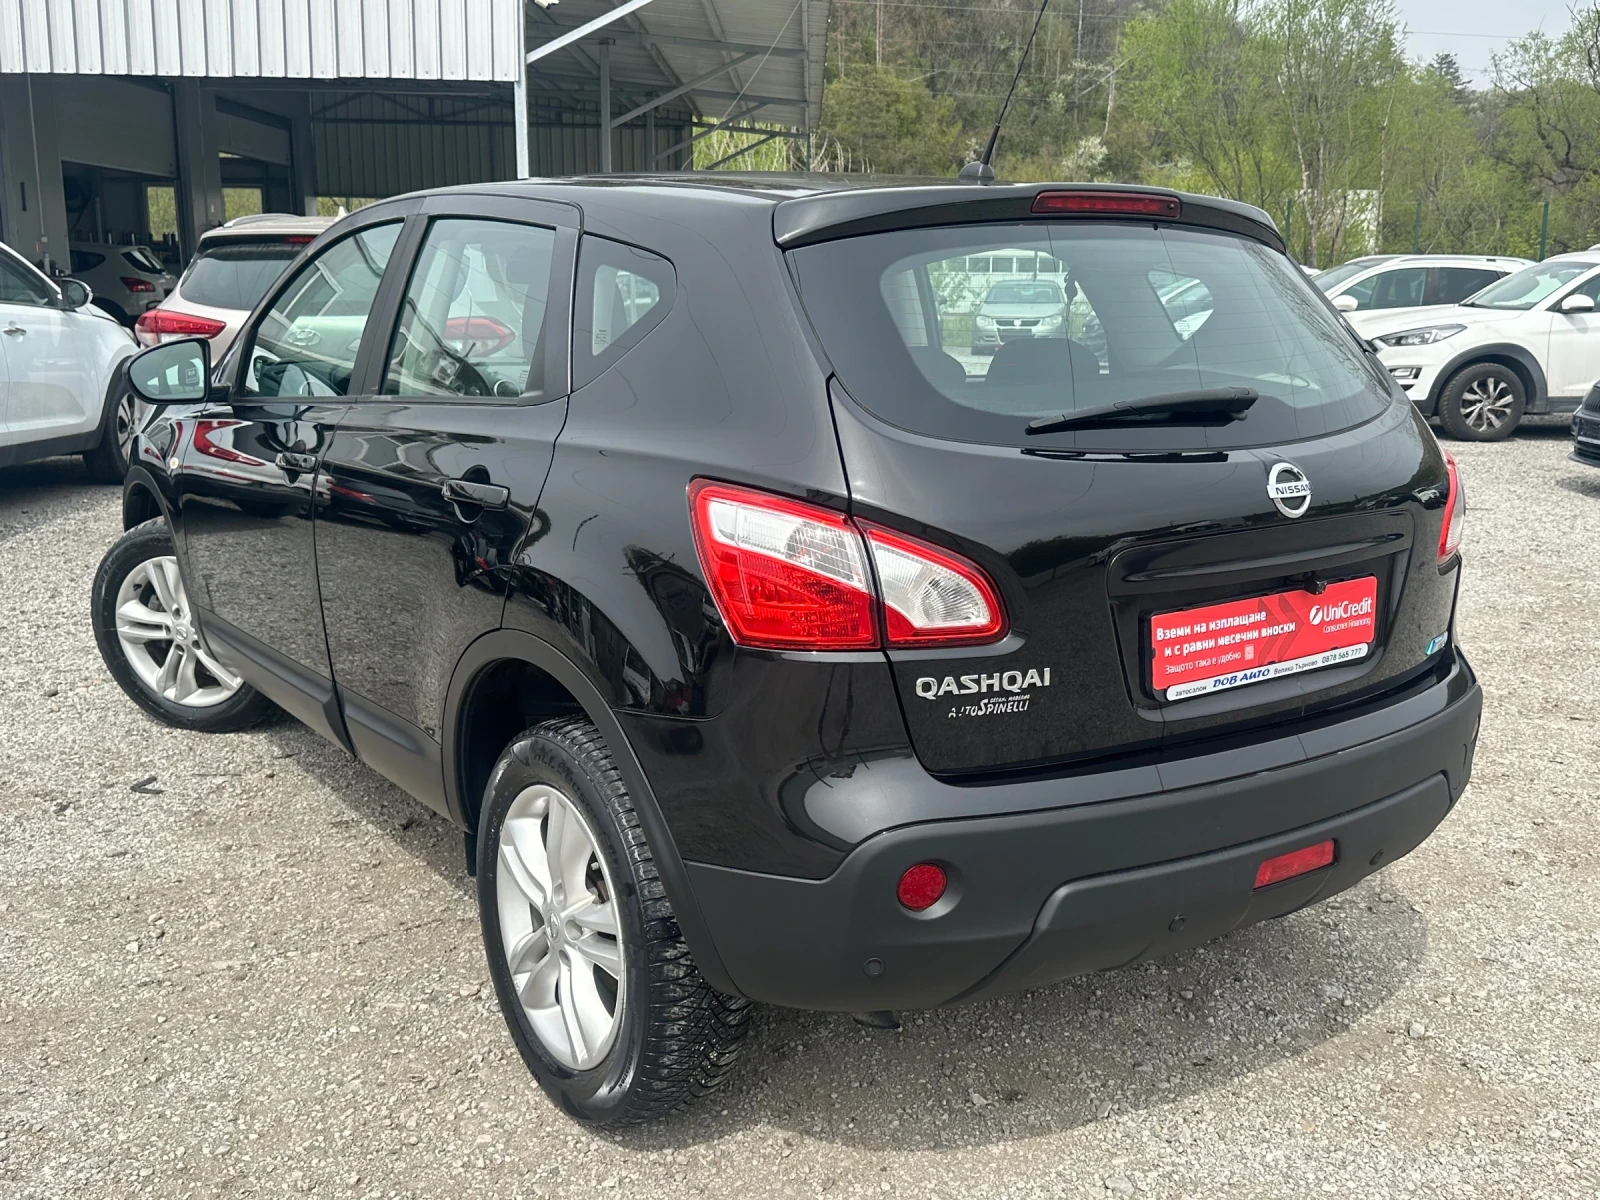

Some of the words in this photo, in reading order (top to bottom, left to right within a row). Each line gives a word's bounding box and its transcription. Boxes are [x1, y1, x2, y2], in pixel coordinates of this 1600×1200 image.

[1275, 483, 1311, 495] NISSAN
[1323, 596, 1372, 622] UniCredit
[1156, 625, 1191, 641] Вземи
[1194, 622, 1207, 634] на
[1209, 611, 1267, 631] изплащане
[1323, 622, 1348, 634] Consumer
[1348, 617, 1372, 628] Financing
[1164, 647, 1172, 657] и
[1174, 646, 1181, 656] с
[1183, 639, 1215, 656] равни
[1217, 629, 1259, 646] месечни
[1261, 622, 1296, 638] вноски
[1165, 661, 1194, 675] Защото
[1195, 659, 1212, 669] така
[1212, 657, 1217, 665] е
[1217, 651, 1242, 665] удобно
[1321, 655, 1337, 664] 0878
[1338, 650, 1349, 660] 565
[1350, 647, 1362, 657] 777
[1273, 665, 1294, 675] Велико
[1295, 660, 1318, 670] Търново
[915, 668, 1051, 700] QASHQAI
[1213, 675, 1238, 688] DOB
[1240, 668, 1271, 683] AUTO
[1175, 685, 1207, 697] автосалон
